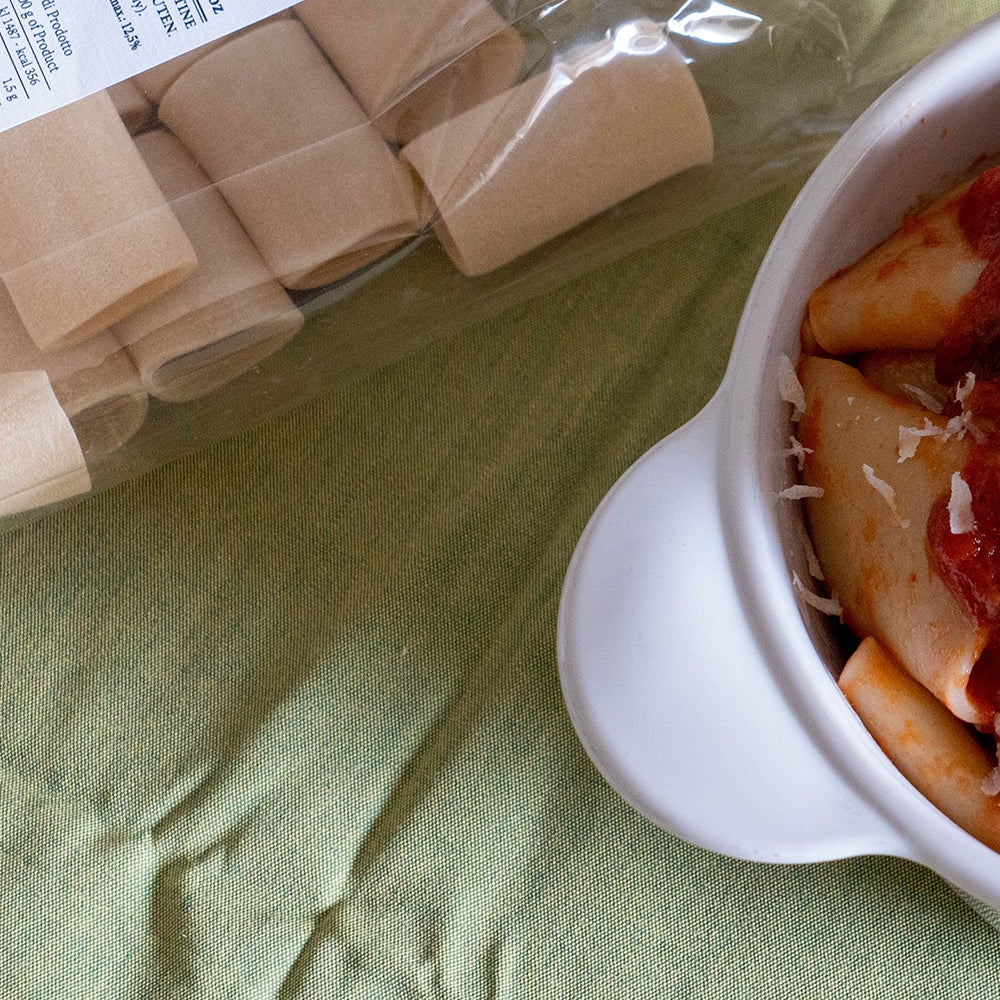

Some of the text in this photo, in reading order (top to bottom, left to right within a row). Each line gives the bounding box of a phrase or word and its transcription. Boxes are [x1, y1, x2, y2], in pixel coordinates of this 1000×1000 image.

[20, 10, 34, 20] g
[41, 0, 56, 11] di
[27, 19, 45, 31] of
[46, 9, 73, 57] Prodotto
[121, 22, 141, 51] 12,5%
[2, 18, 21, 39] 1487
[15, 46, 33, 68] kcal
[24, 67, 41, 86] 356
[33, 30, 59, 74] Product
[2, 77, 18, 102] 1,5 g
